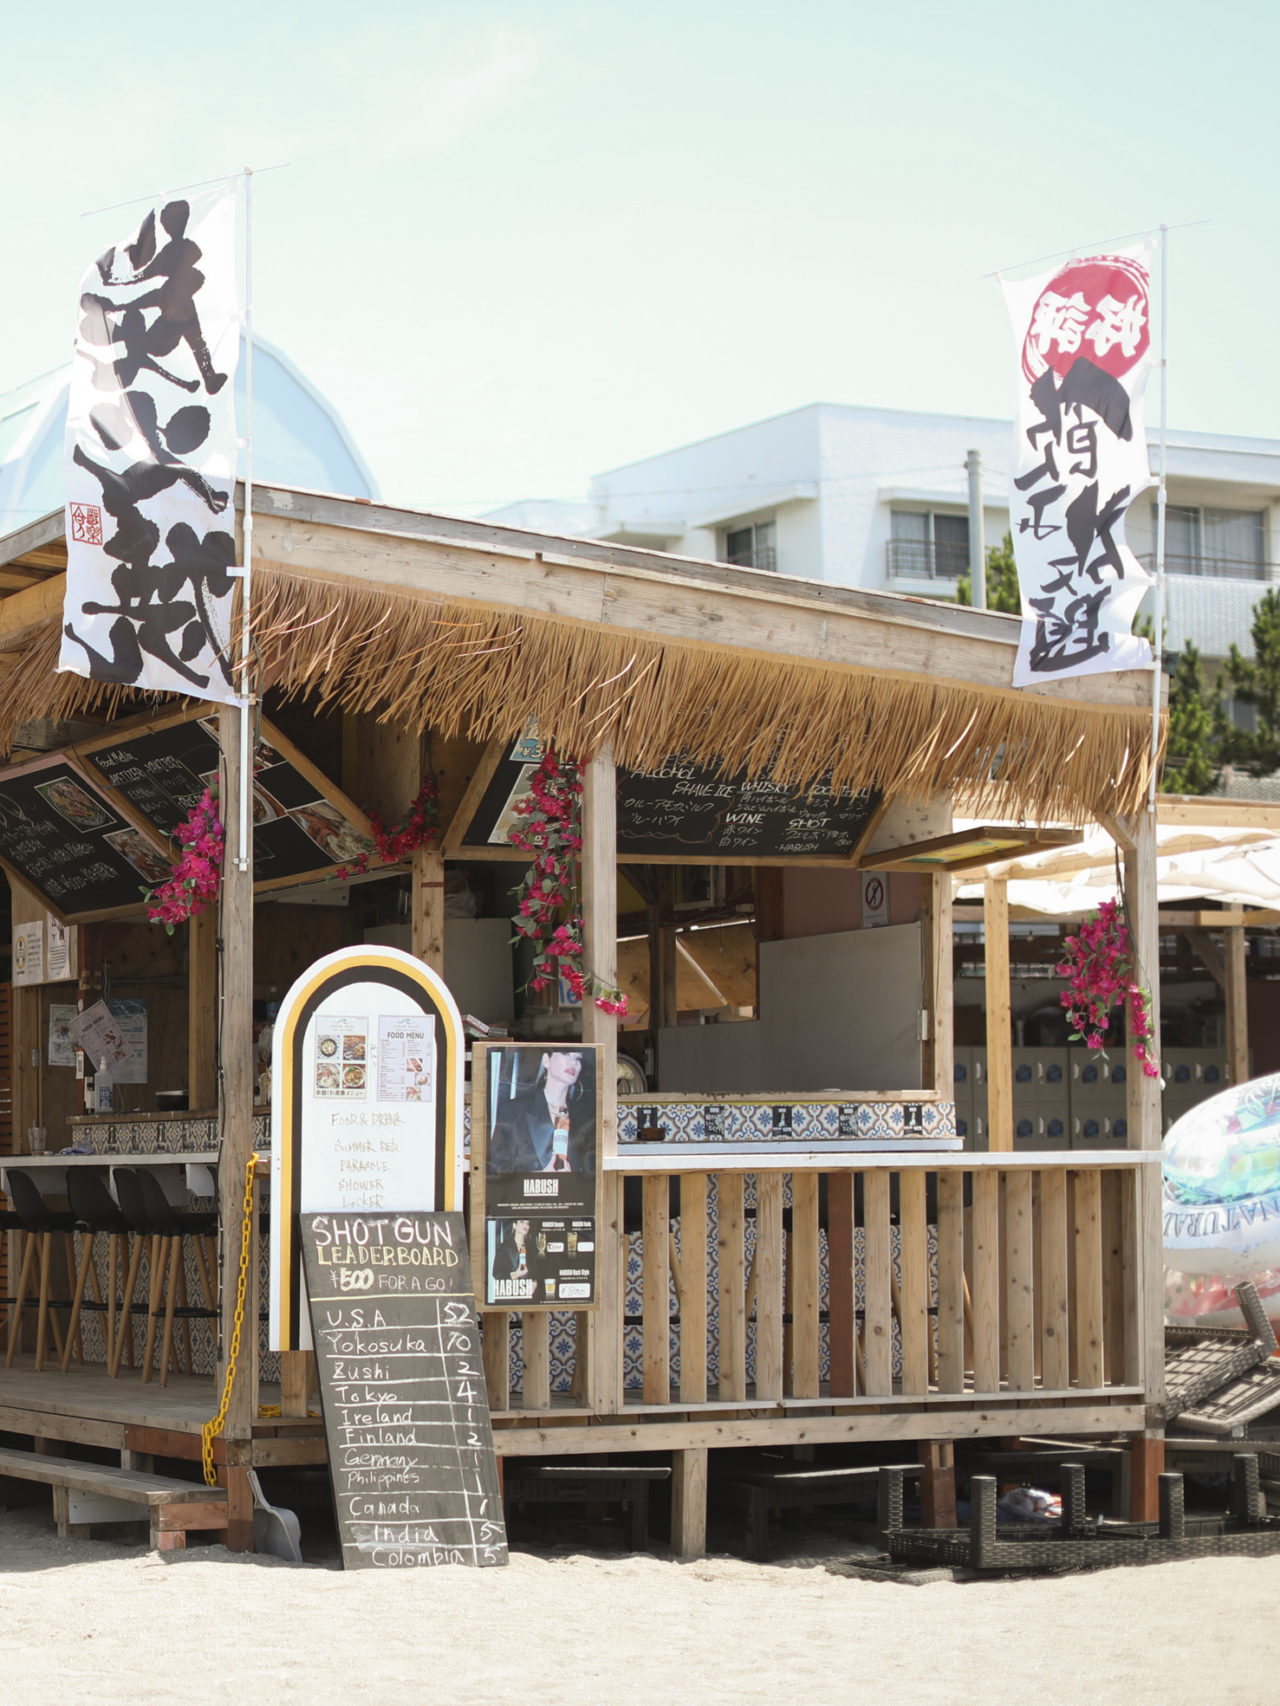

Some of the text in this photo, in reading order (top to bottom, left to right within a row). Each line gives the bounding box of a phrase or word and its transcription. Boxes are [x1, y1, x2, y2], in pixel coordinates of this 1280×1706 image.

[672, 781, 737, 798] SHAVE ICE
[741, 781, 793, 793] WHISKY
[725, 812, 767, 824] WINE
[788, 817, 831, 829] SHOT
[387, 1032, 424, 1040] FOOD MENU
[523, 1178, 559, 1194] HABUSH
[316, 1246, 459, 1267] LEADERBOARD
[378, 1274, 408, 1290] FOR
[411, 1277, 421, 1290] A
[493, 1279, 533, 1296] HABUSH
[326, 1331, 472, 1355] Yokosuka 70
[332, 1361, 480, 1380] Zushi 2
[335, 1381, 477, 1406] Tokyo 4
[342, 1407, 412, 1426] Ireland
[345, 1428, 483, 1446] Finland 2
[344, 1448, 418, 1474] Germany
[347, 1471, 420, 1489] Philippines
[349, 1496, 420, 1516] Canada
[374, 1524, 439, 1543] India
[371, 1547, 465, 1566] Colombia
